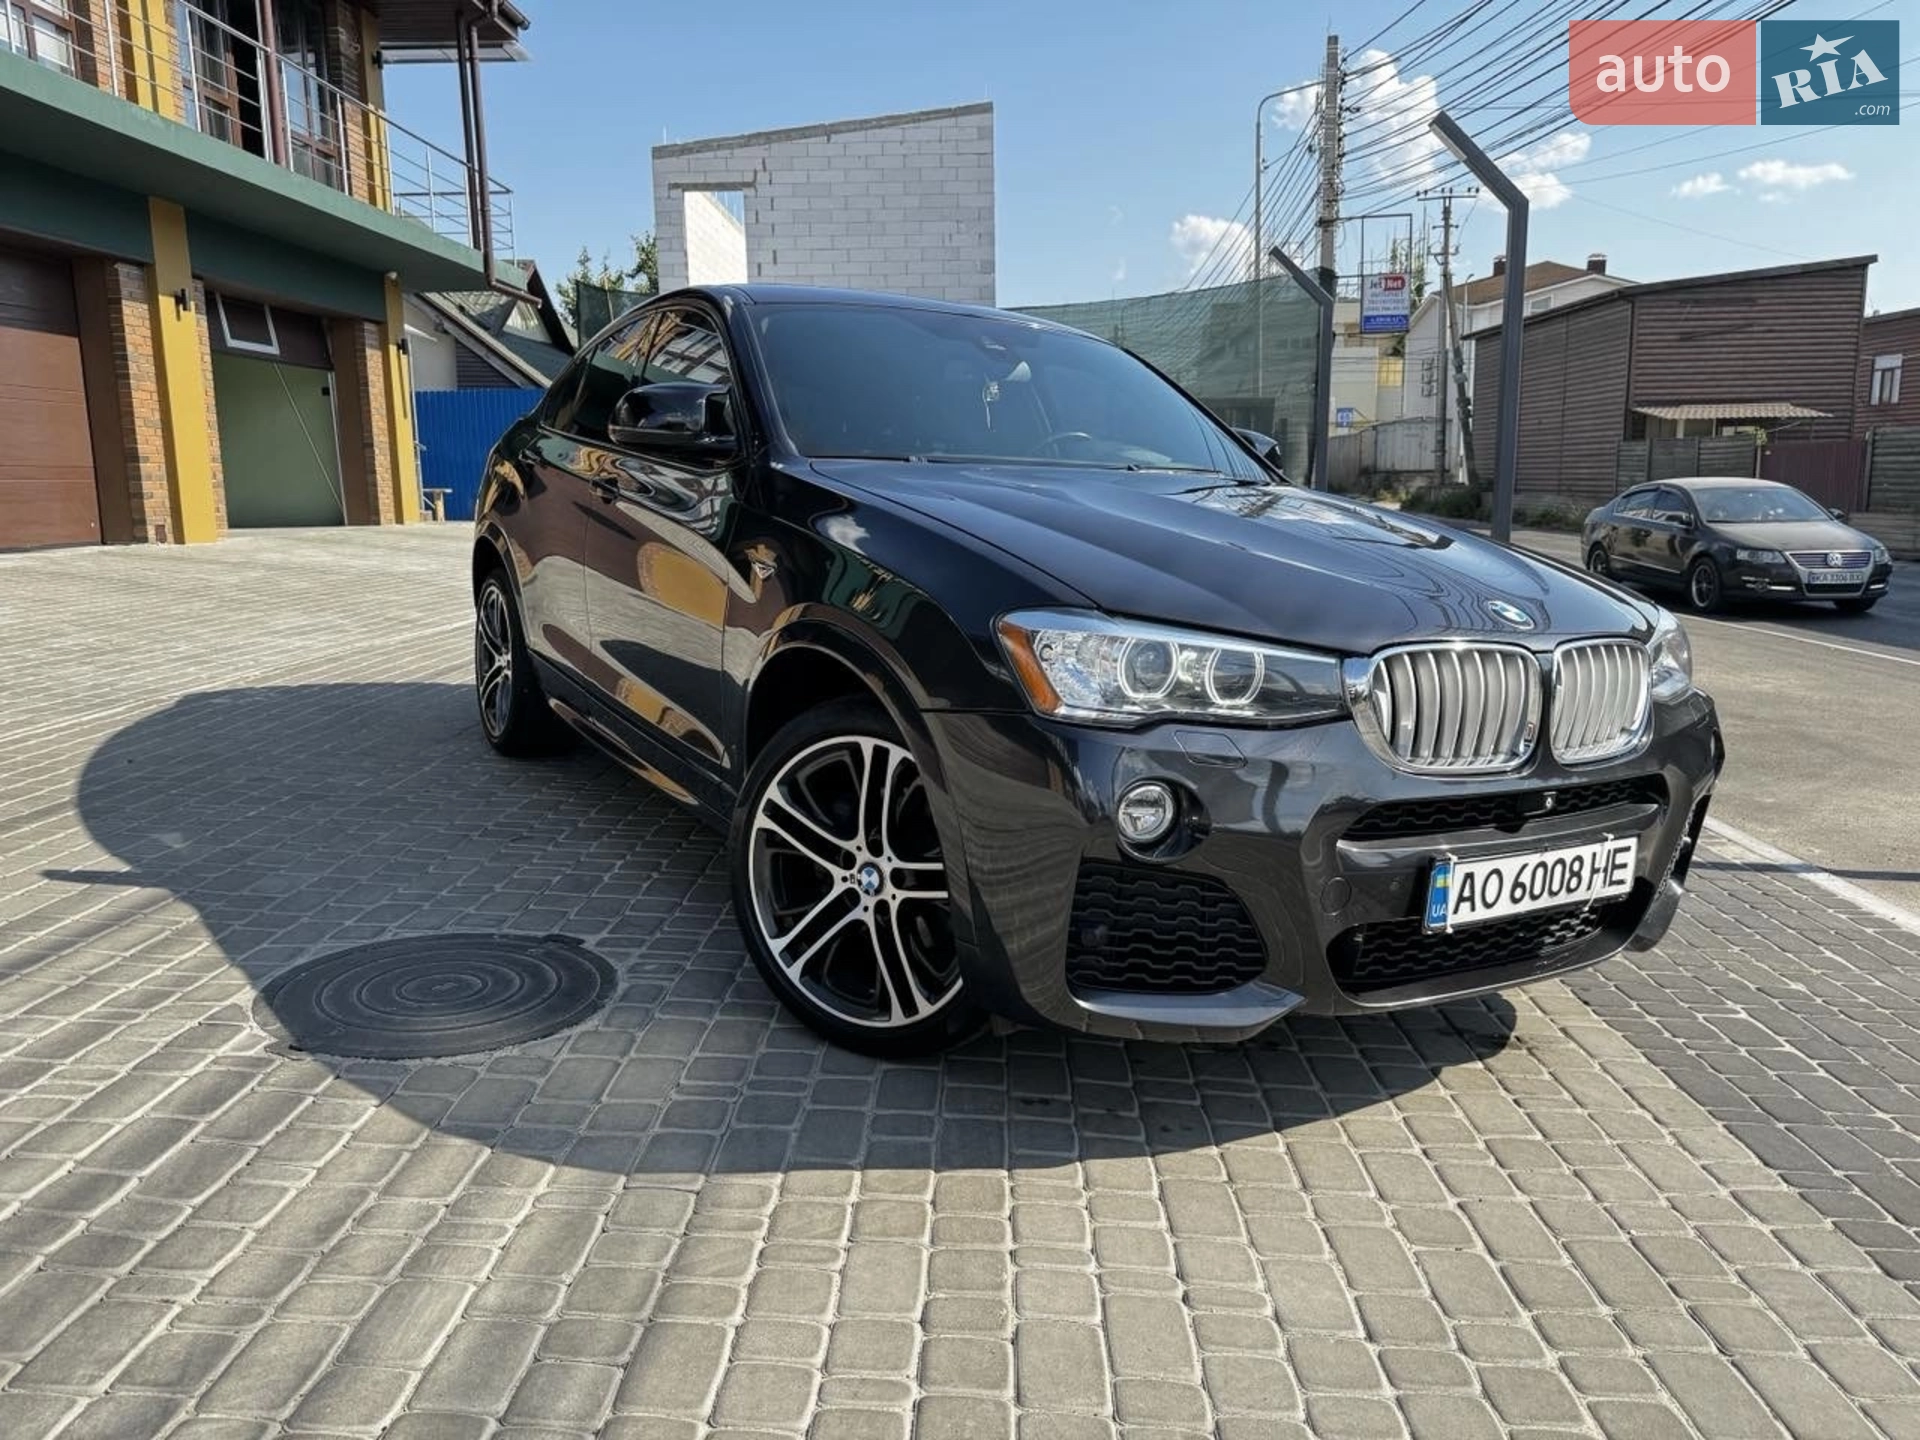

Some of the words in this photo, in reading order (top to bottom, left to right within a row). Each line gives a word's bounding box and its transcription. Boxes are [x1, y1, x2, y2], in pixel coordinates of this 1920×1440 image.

[1453, 868, 1504, 915] AO
[1510, 854, 1585, 905] 6008
[1587, 845, 1632, 891] HE
